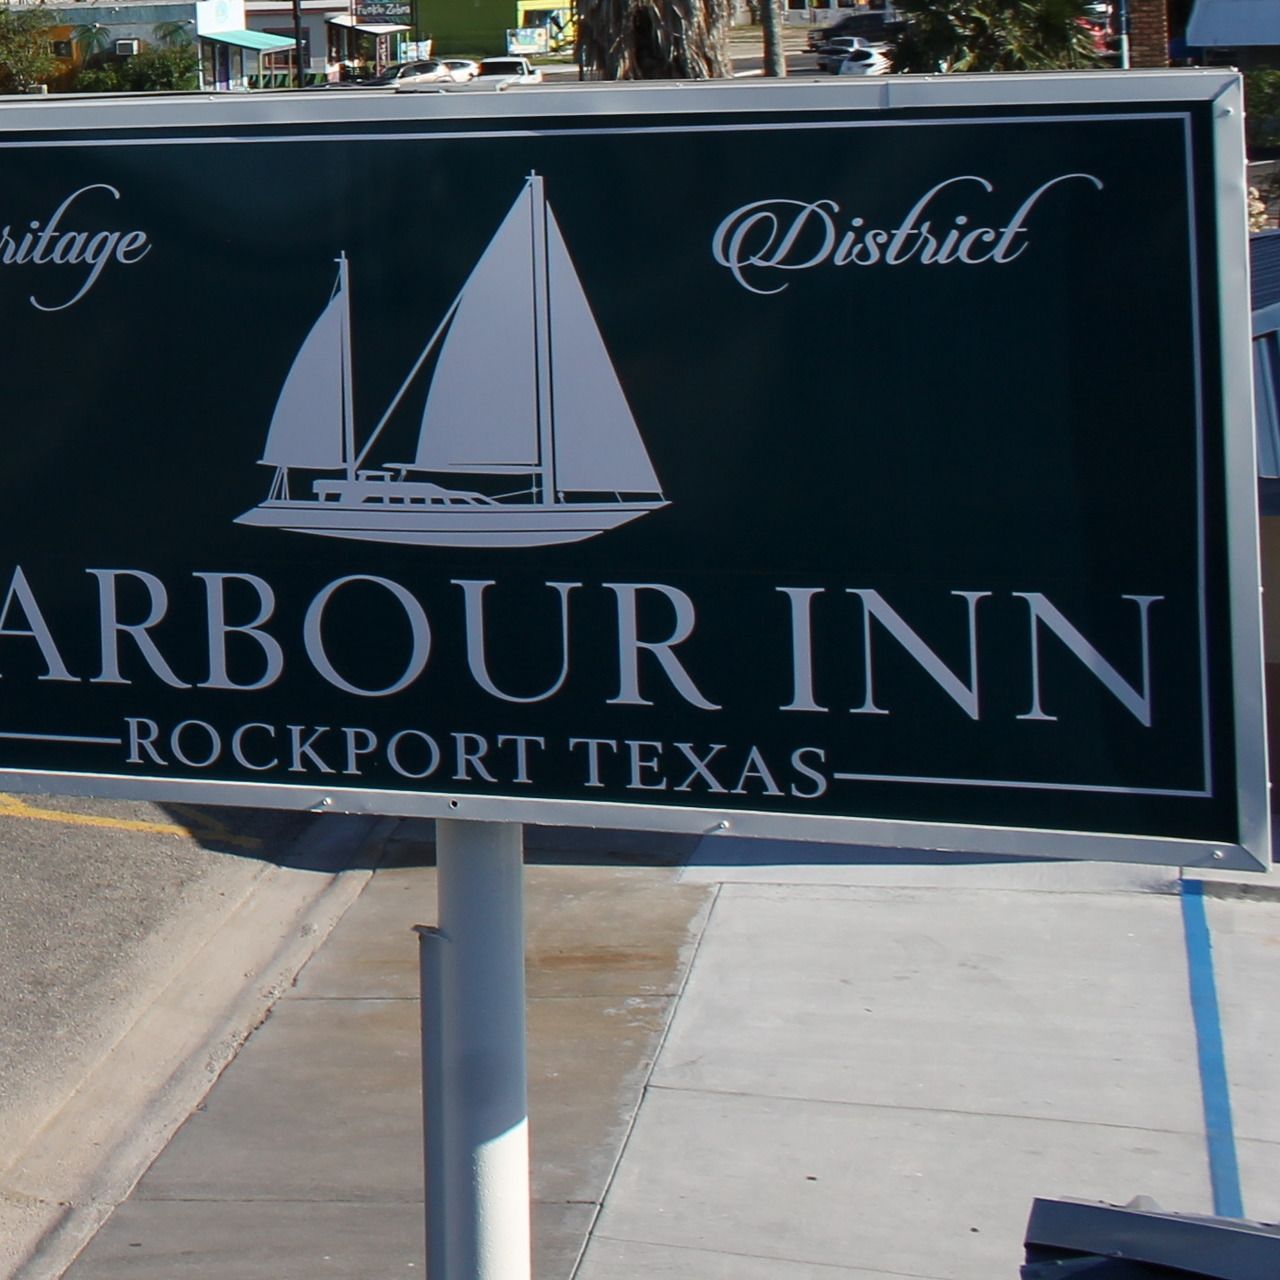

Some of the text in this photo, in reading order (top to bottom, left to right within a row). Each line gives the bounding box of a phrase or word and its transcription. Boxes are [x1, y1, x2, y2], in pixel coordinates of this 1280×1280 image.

[713, 174, 1102, 294] District
[776, 587, 1164, 726] INN
[125, 718, 826, 798] ROCKPORT TEXAS
